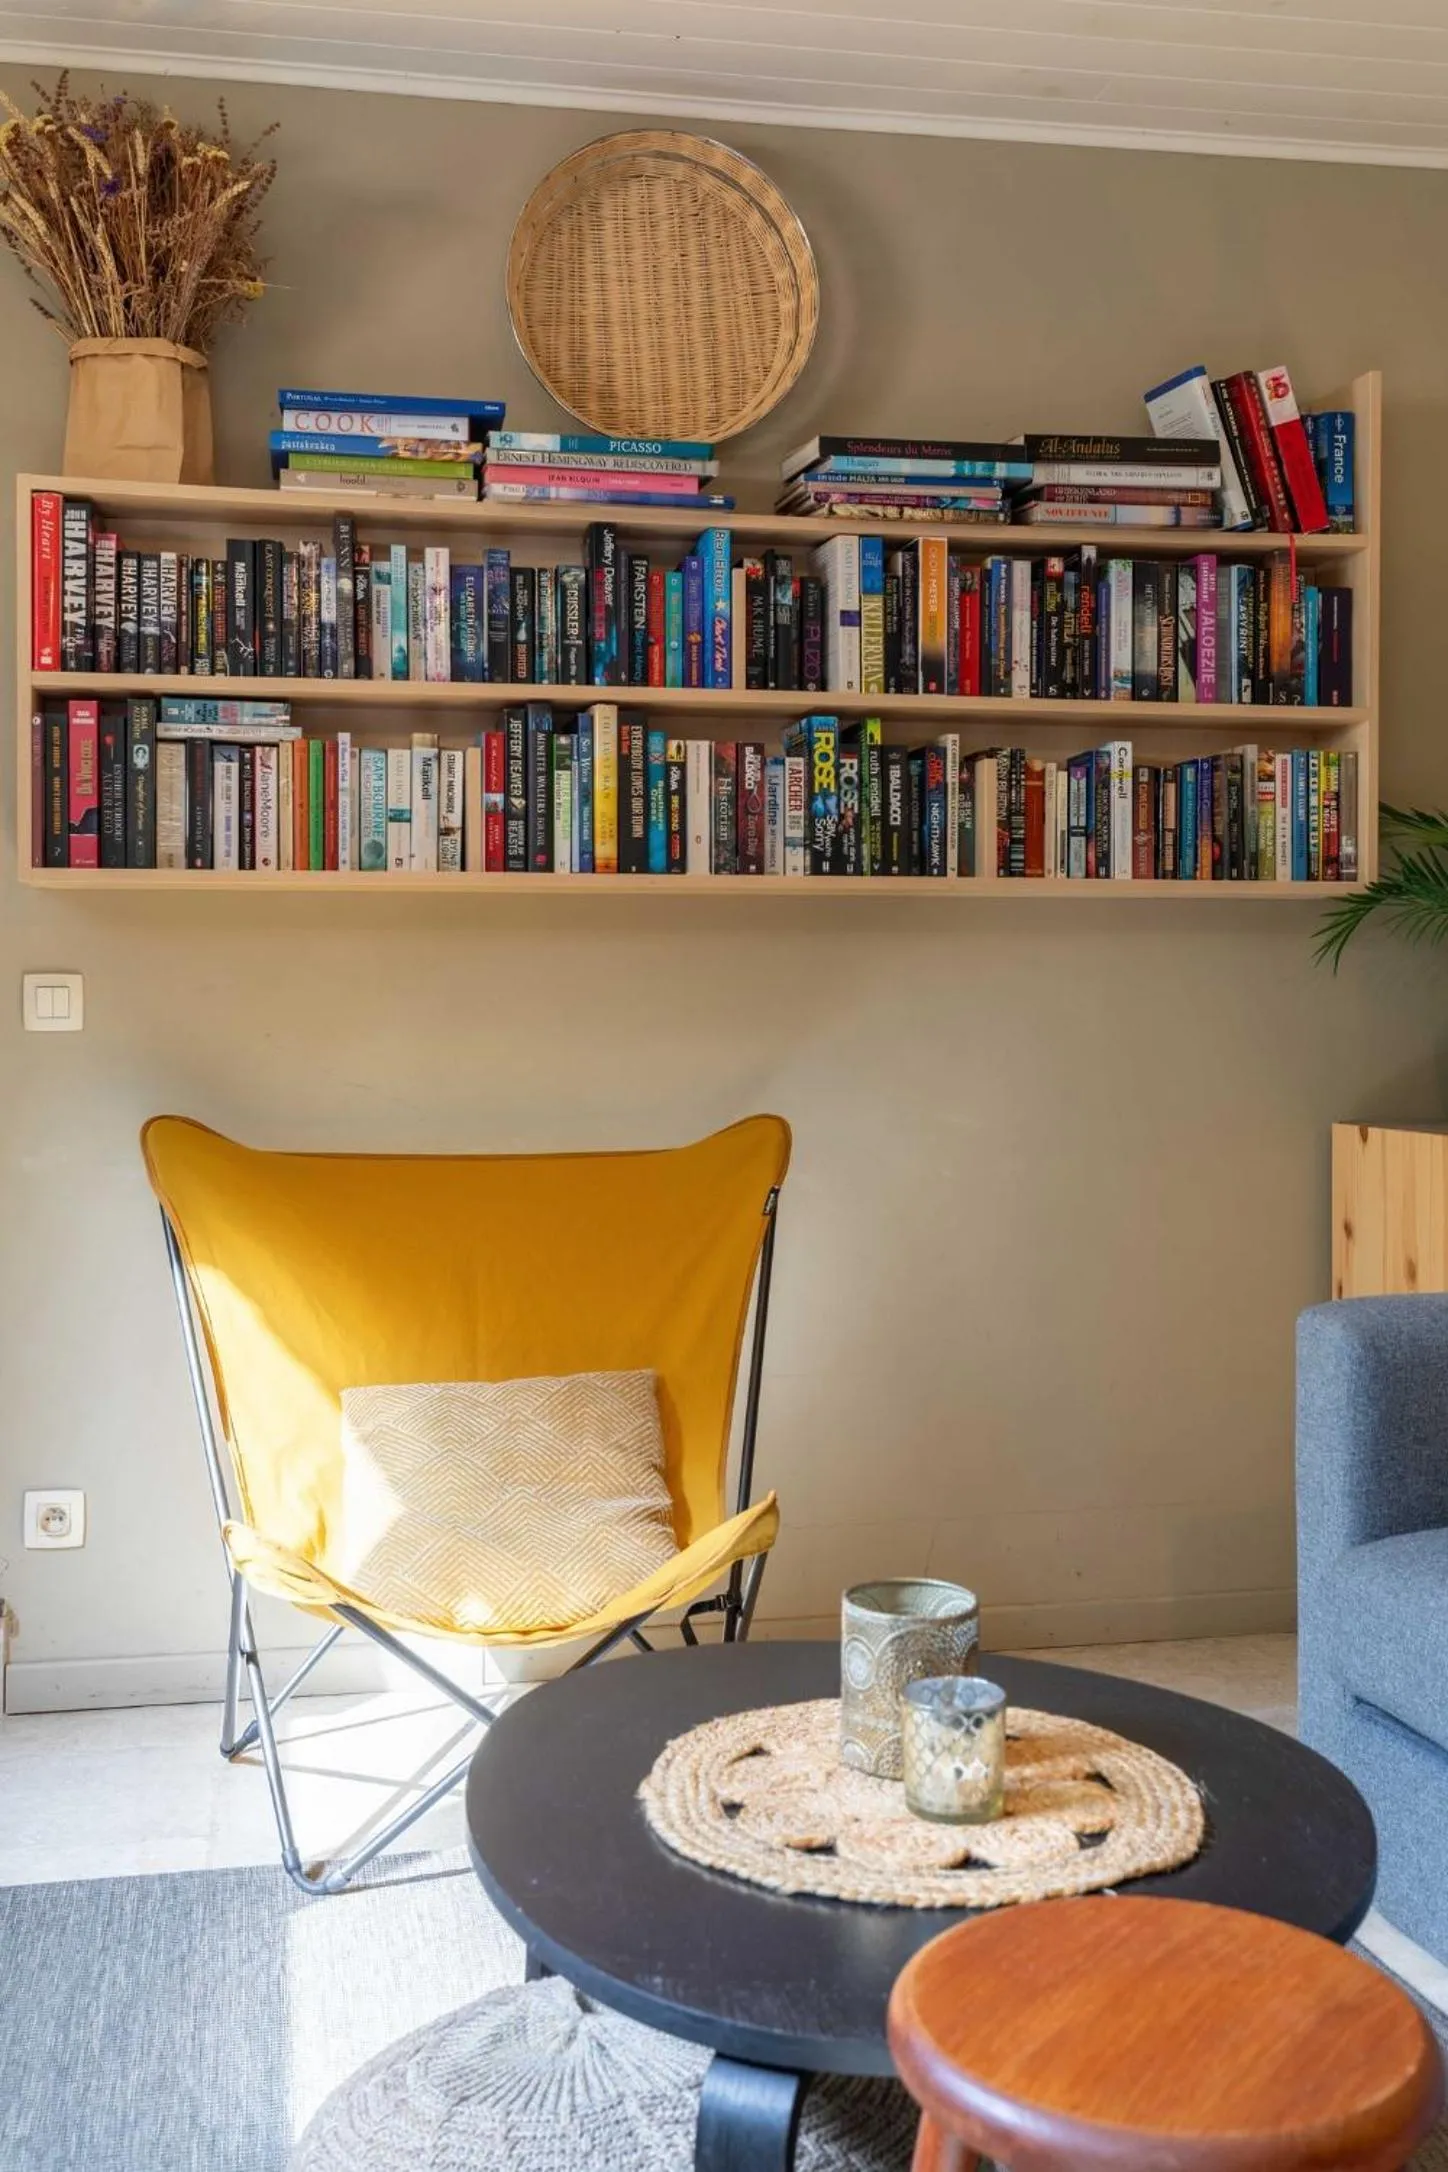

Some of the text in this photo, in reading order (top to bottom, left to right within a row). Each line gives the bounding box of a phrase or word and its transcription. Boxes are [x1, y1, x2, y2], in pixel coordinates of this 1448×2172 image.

[295, 412, 375, 433] COOK
[610, 440, 662, 453] PICASSO
[906, 443, 918, 455] du
[496, 452, 692, 472] ERNEST HEMINGWAY REDISCOVERED
[1334, 434, 1347, 484] France
[40, 499, 53, 560] By Heart
[65, 520, 87, 627] HARVEY
[234, 562, 246, 606] Mankell
[602, 529, 615, 606] Jeffery Deaver
[714, 531, 727, 593] Ben Elton
[96, 550, 116, 629] HARVEY
[121, 567, 137, 621] HARVEY
[142, 568, 157, 621] HARVEY
[162, 566, 177, 620] HARVEY
[567, 589, 579, 634] CUSSLER
[634, 566, 646, 629] FAIRSTEIN
[928, 578, 937, 612] MEYER
[1080, 585, 1093, 635] rendell
[466, 577, 476, 663] ELIZABETH GEORGE
[753, 596, 765, 658] MK HUME
[864, 602, 883, 684] KELLERMAN
[1201, 608, 1216, 684] JALOEZIE
[1238, 597, 1248, 656] LABYRINT
[805, 626, 819, 680] PUZO
[421, 757, 433, 800] Mankell
[447, 754, 456, 778] STUART
[509, 718, 522, 796] JEFFERY DEAVER
[536, 732, 547, 772] MINETTE
[814, 731, 835, 793] ROSE
[1118, 746, 1129, 799] Cornwell
[373, 757, 384, 838] SAM BOURNE
[536, 775, 547, 814] WALTERS
[631, 725, 644, 839] EVERYBODY LOVES OUR TOWN
[768, 780, 779, 826] Jardine
[788, 767, 803, 812] ARCHER
[840, 758, 858, 814] ROSE
[869, 751, 881, 817] ruth rendell
[889, 769, 901, 826] BALDACCI
[718, 777, 732, 841] Historian
[746, 814, 758, 857] Zero Day
[813, 818, 826, 851] Sorry
[825, 815, 838, 837] Say
[930, 802, 940, 866] NIGHTHAWK
[441, 838, 449, 865] LIGHT
[449, 839, 457, 866] DYING
[508, 820, 518, 856] BEASTS
